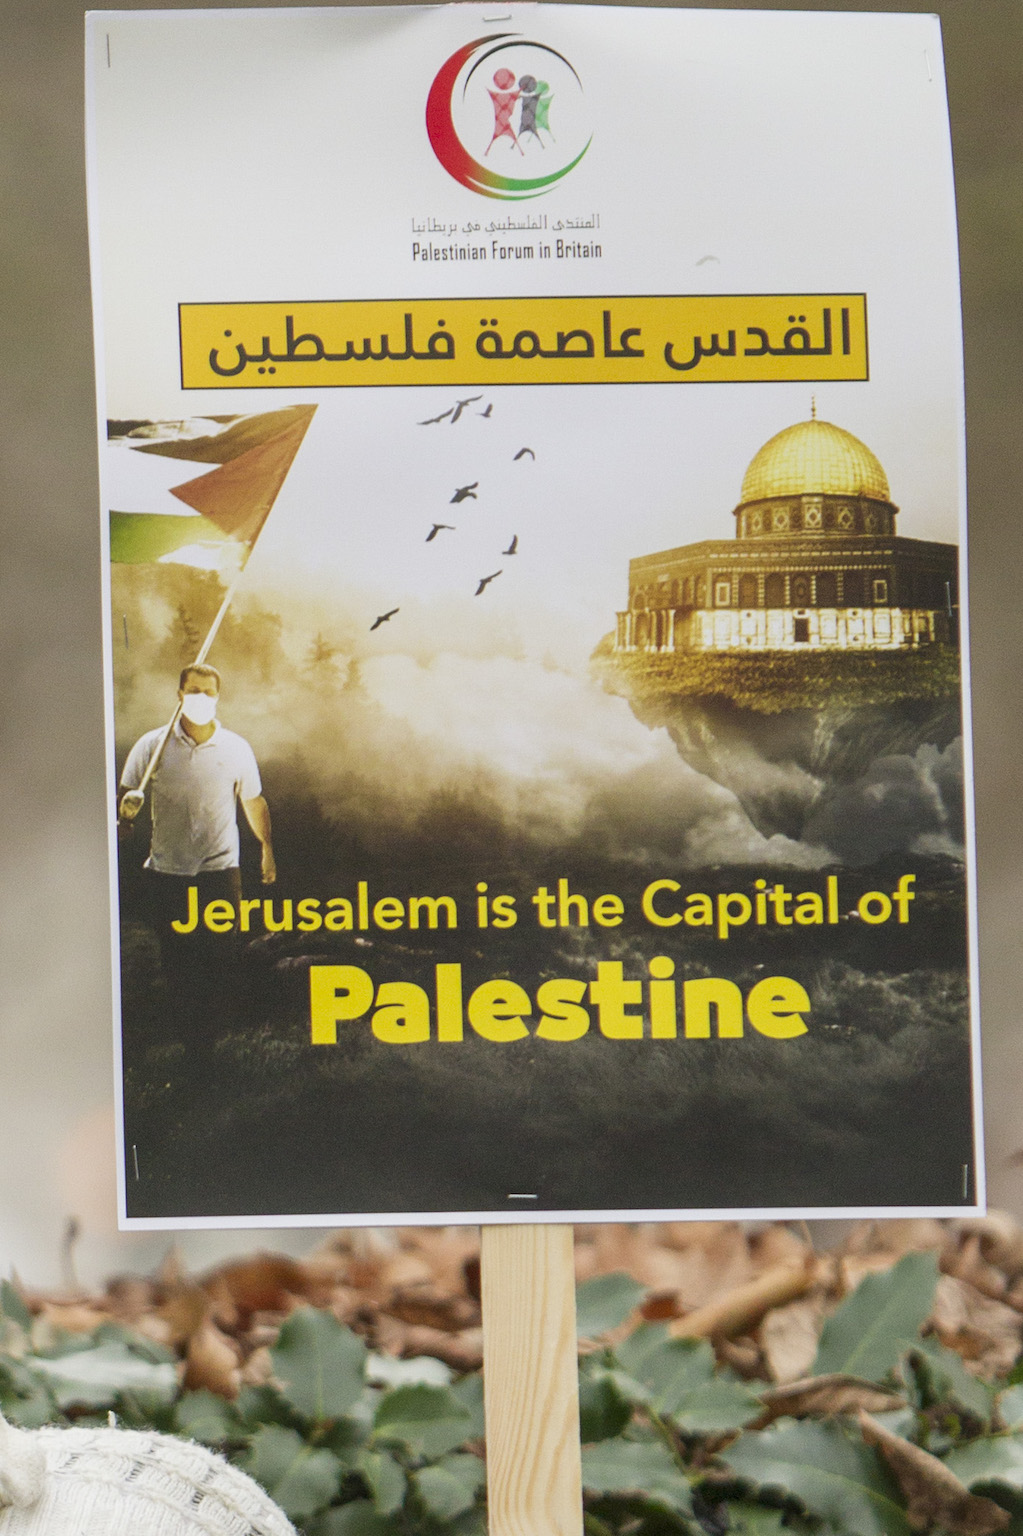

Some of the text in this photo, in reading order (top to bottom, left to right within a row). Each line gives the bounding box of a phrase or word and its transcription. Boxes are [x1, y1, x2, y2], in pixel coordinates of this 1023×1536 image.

[412, 239, 603, 262] Palestinian Forum in Britain
[208, 307, 851, 377] القدس عاصمة فلسطين
[171, 874, 916, 940] Jerusalem is the Capital of
[309, 955, 811, 1045] Palestine
